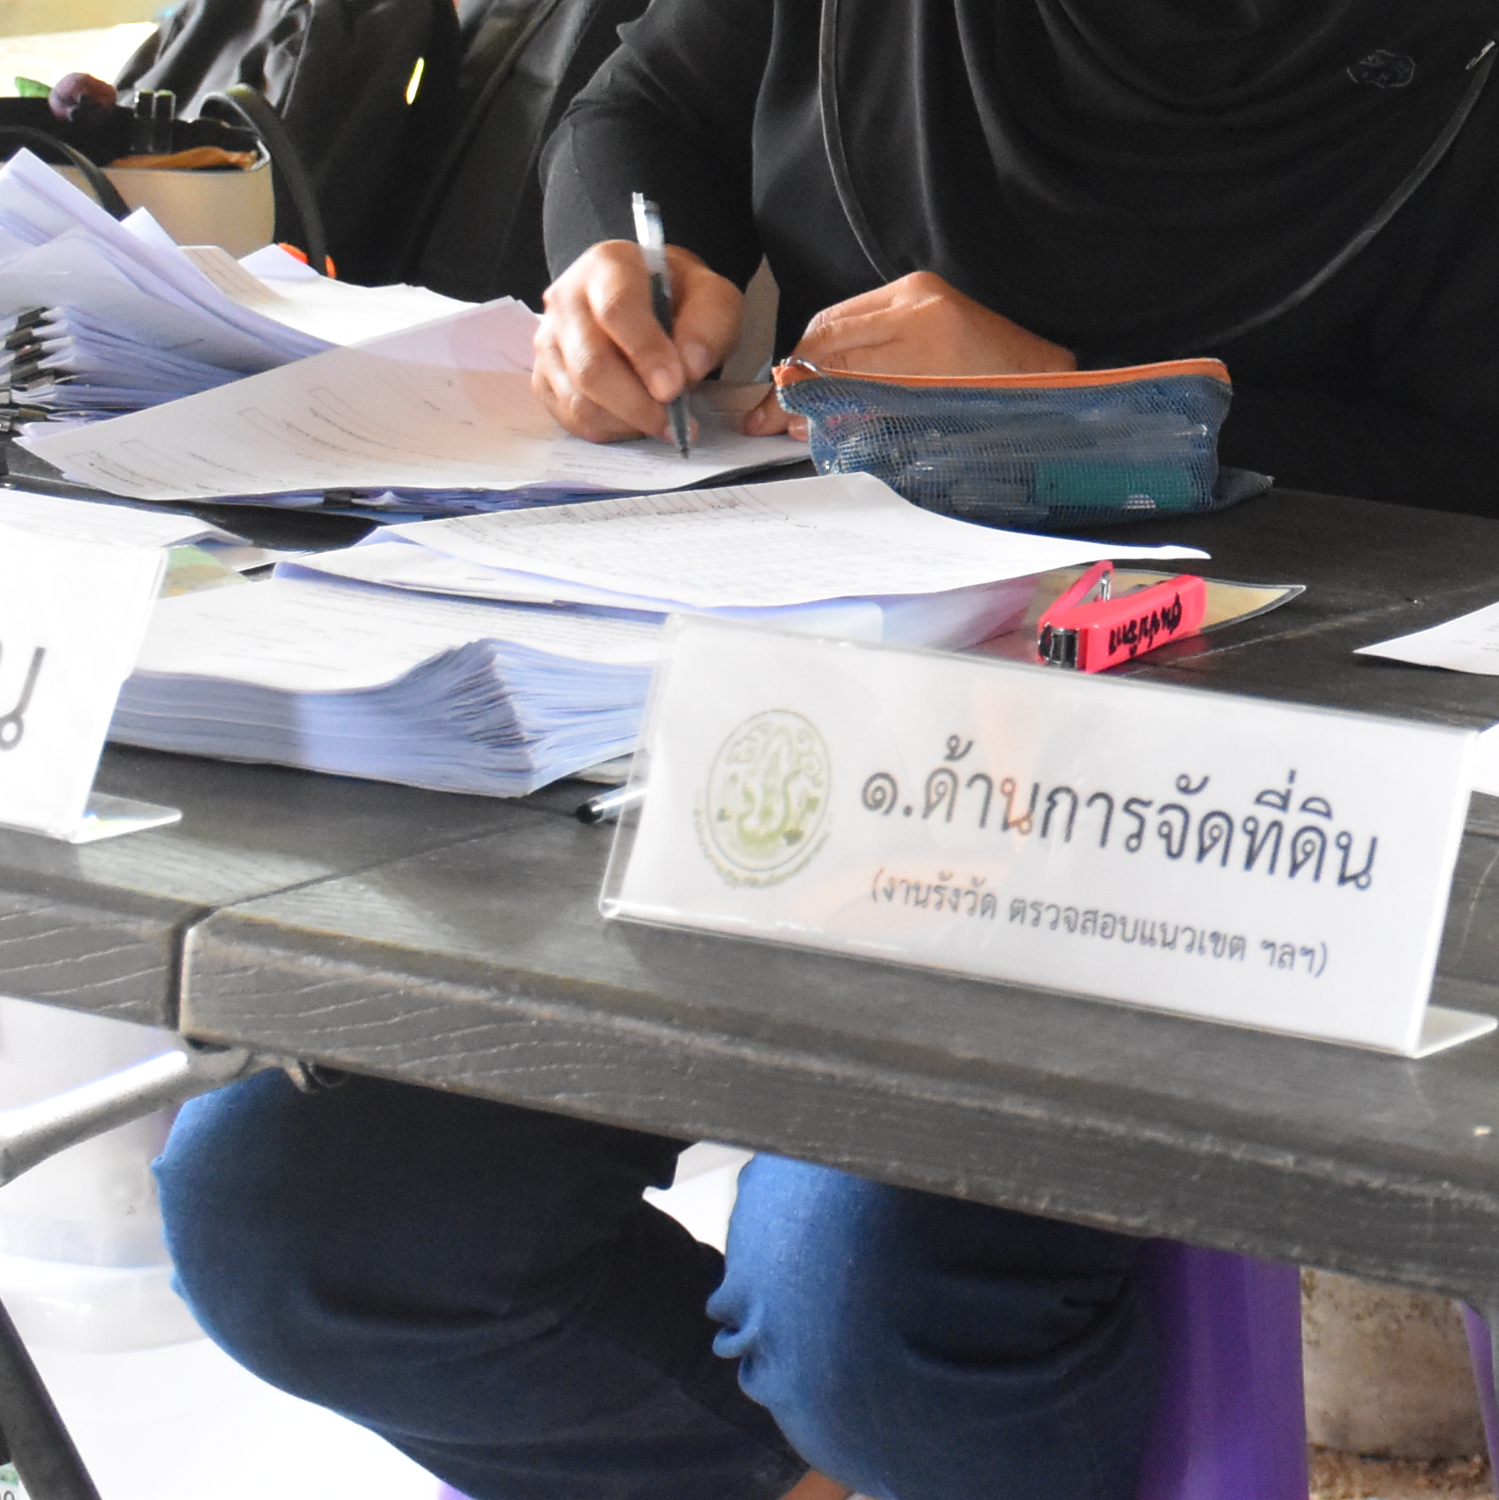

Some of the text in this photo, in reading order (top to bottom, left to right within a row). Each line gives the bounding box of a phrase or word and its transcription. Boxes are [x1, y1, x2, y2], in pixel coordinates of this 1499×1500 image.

[861, 733, 1380, 892] ๑.ด้านการจัดที่ดิน
[871, 866, 998, 921] (งานรังวัด
[1008, 899, 1247, 962] ตรวจสอบแนวเขต
